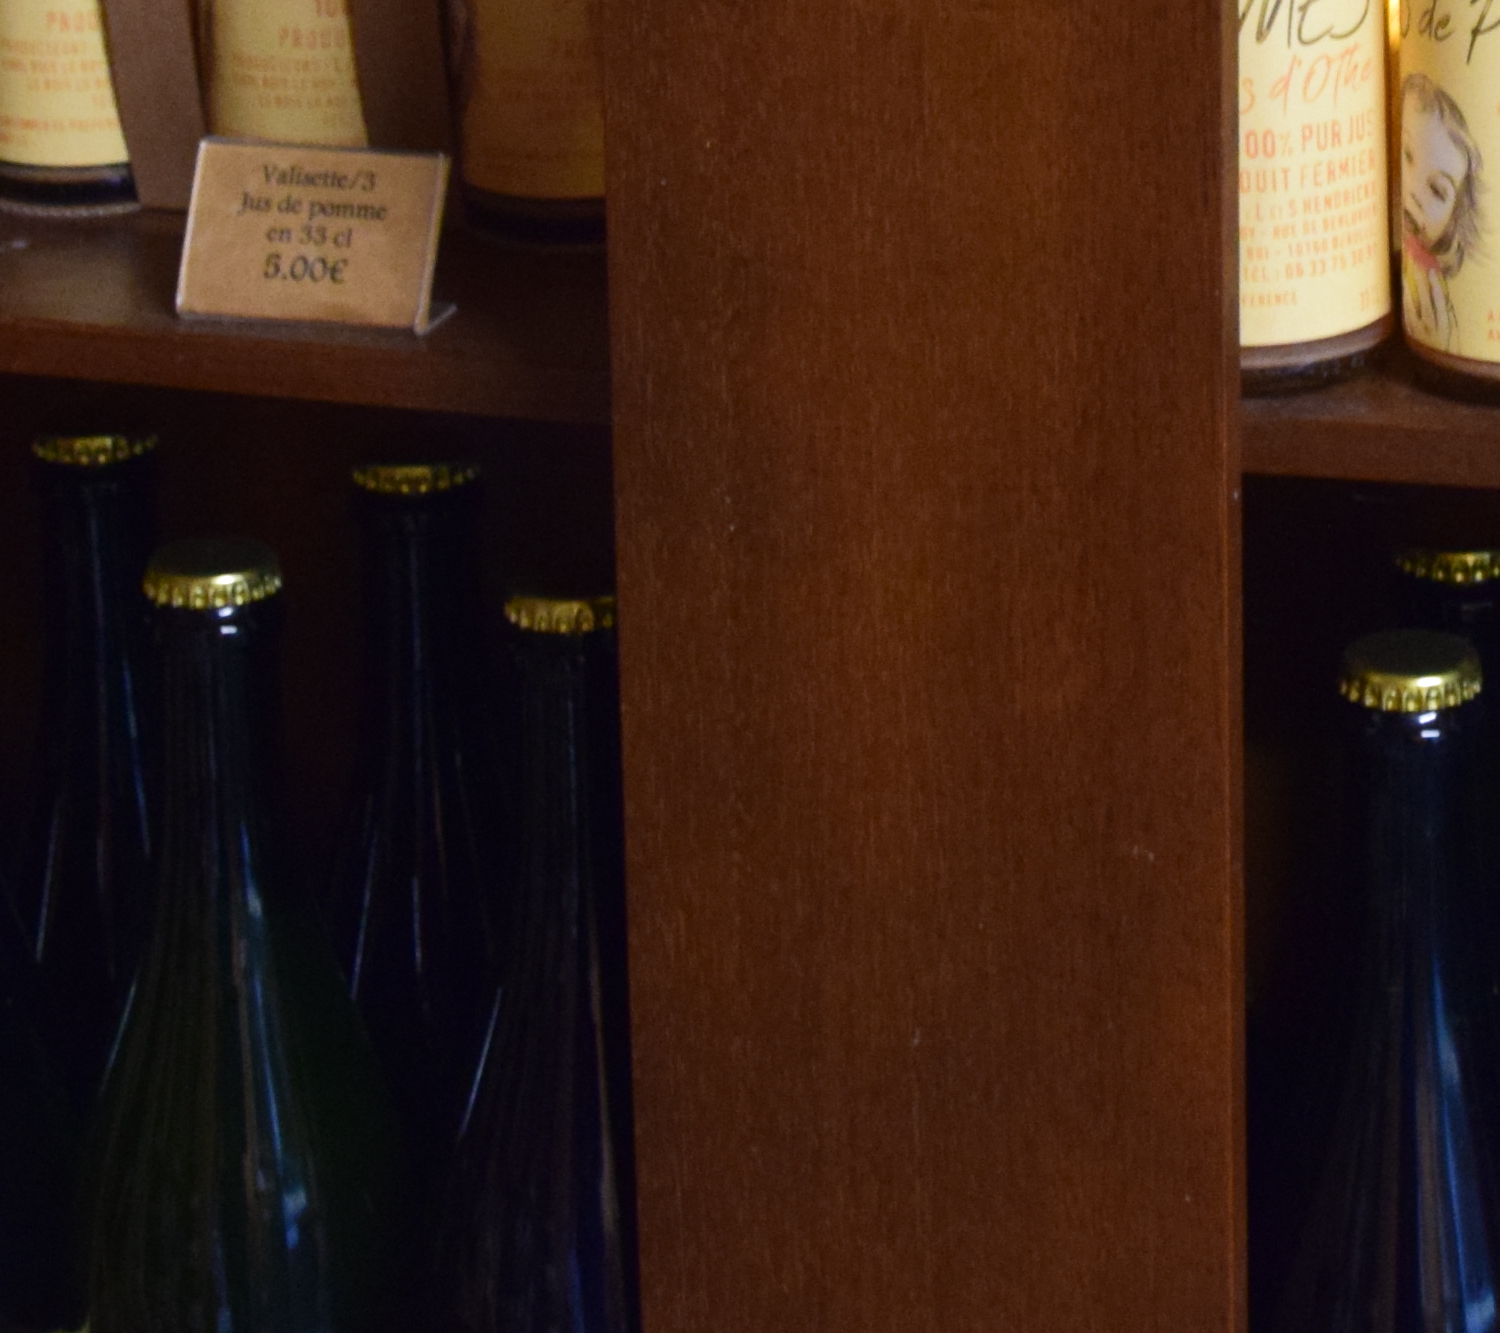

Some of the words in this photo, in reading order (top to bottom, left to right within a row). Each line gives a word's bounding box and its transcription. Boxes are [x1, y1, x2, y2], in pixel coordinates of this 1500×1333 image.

[1301, 120, 1342, 153] PUR
[1350, 110, 1374, 142] JUS
[262, 163, 377, 191] Valisette/3
[1301, 148, 1376, 189] FERMIER
[237, 191, 271, 215] Jus
[277, 194, 301, 215] de
[308, 199, 387, 221] pomme
[266, 226, 292, 243] en
[301, 224, 327, 245] 33
[333, 228, 352, 248] cl
[264, 252, 348, 283] 5.00€
